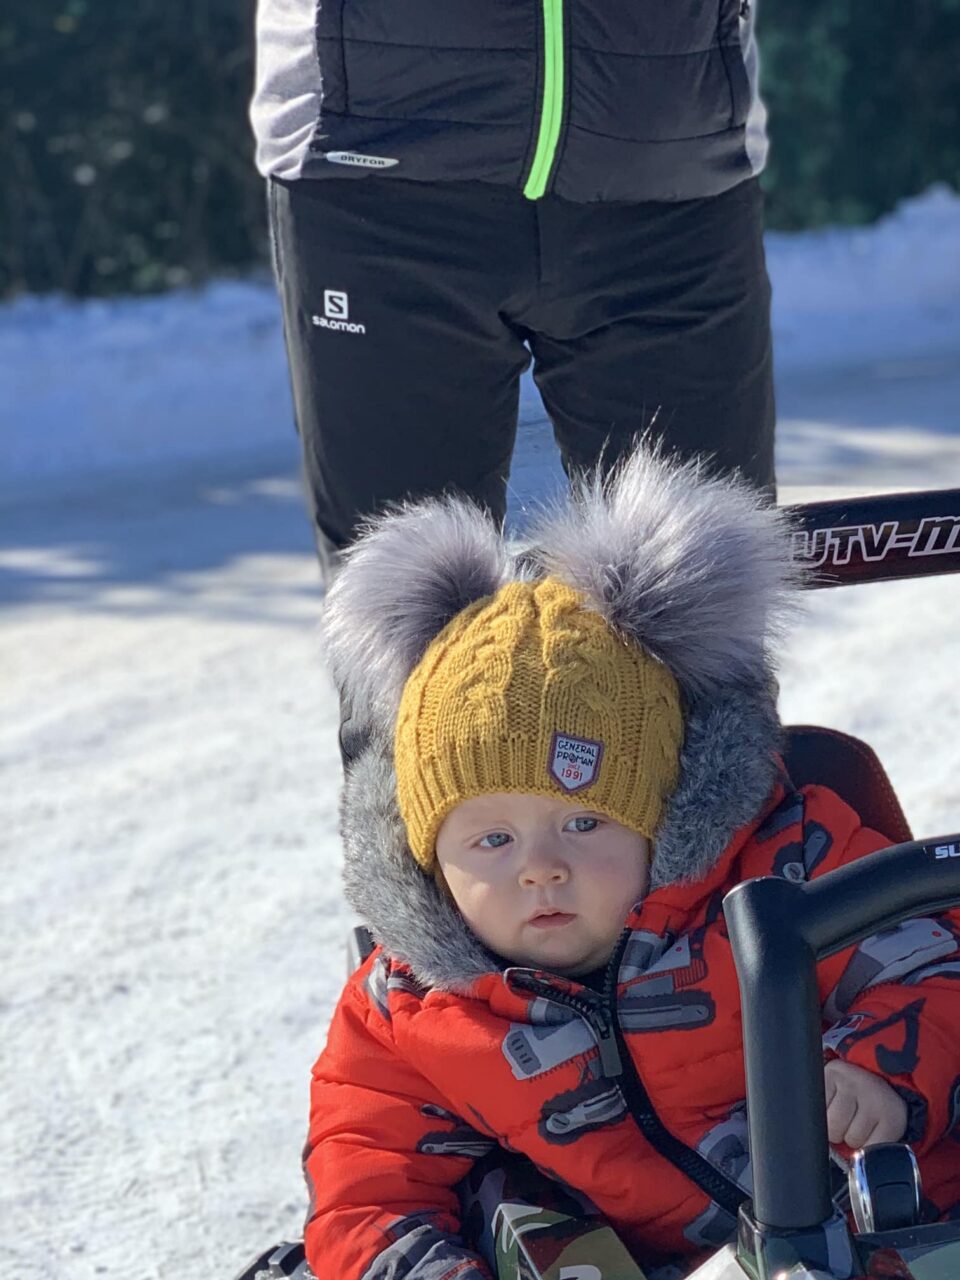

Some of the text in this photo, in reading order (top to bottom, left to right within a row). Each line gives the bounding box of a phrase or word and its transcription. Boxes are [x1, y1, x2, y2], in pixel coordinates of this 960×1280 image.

[341, 155, 386, 167] DRYFOR
[558, 740, 596, 758] GENERAL
[556, 751, 594, 767] PROMAN
[561, 767, 583, 781] 1991
